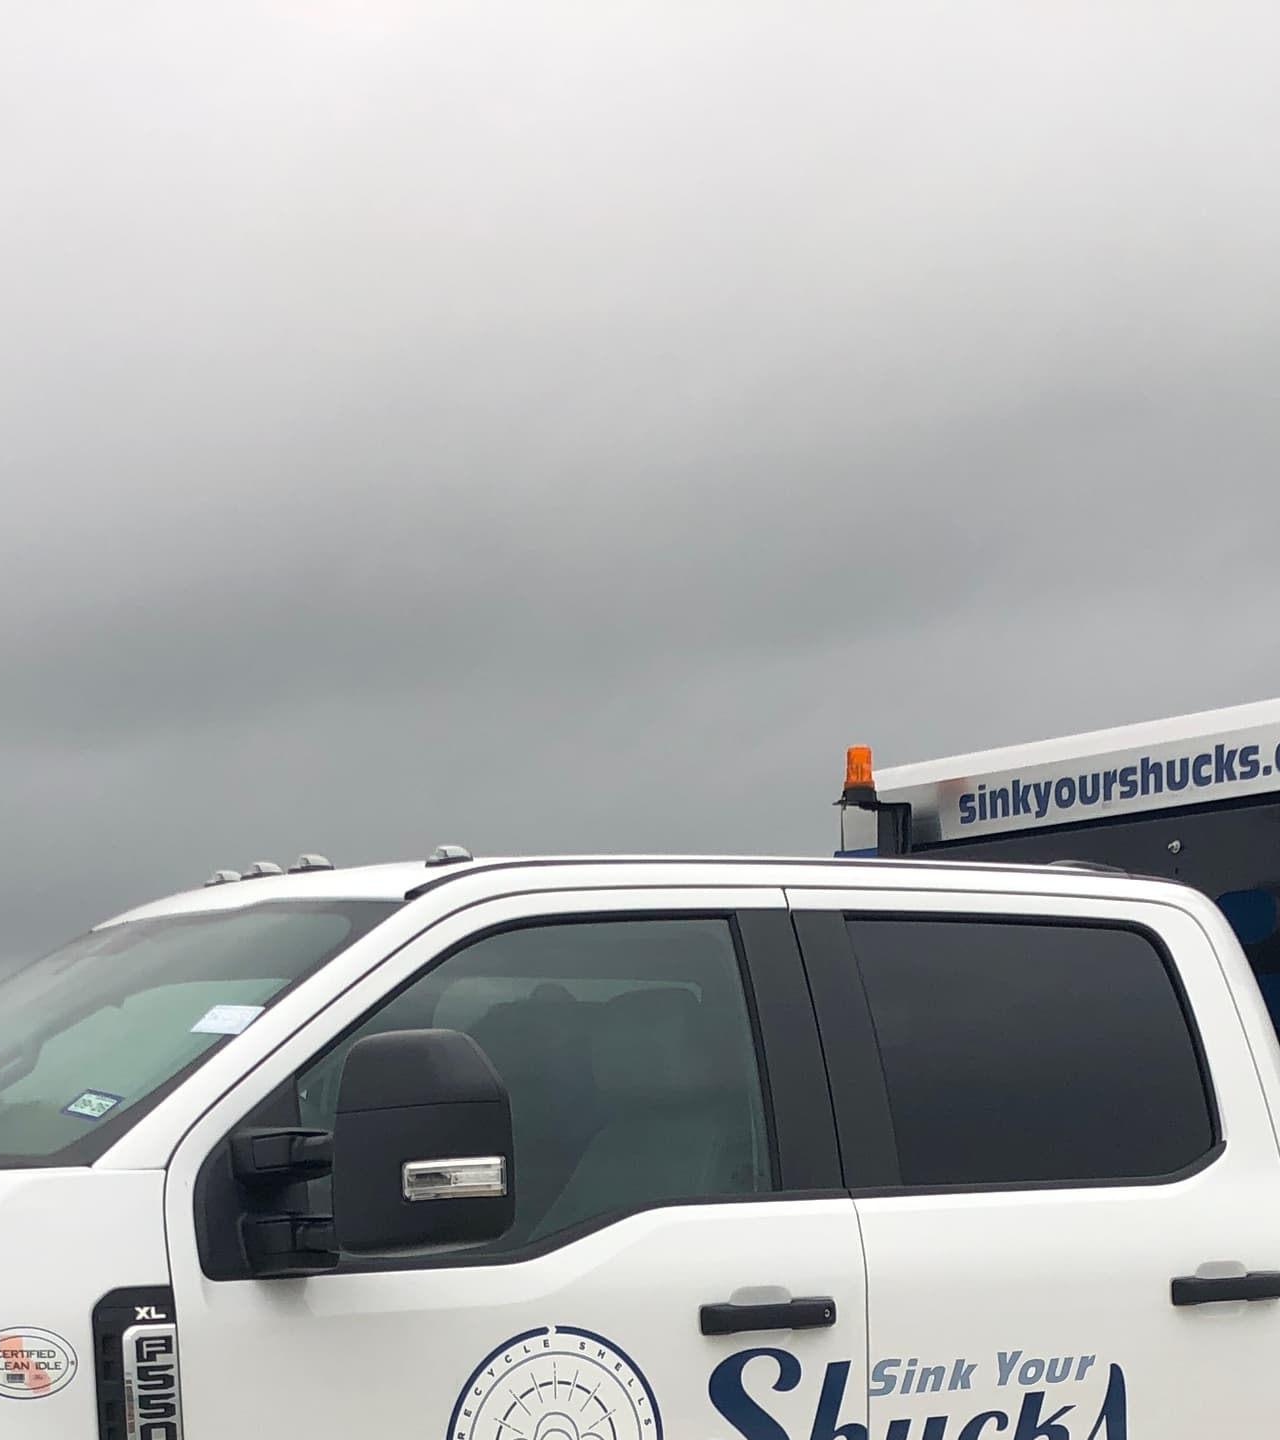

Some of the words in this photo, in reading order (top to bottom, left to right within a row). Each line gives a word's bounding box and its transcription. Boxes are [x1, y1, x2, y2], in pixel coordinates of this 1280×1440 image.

[135, 1306, 166, 1320] XL
[35, 1361, 62, 1370] IDLE
[869, 1357, 978, 1397] Sink
[997, 1351, 1096, 1387] Your
[457, 1339, 551, 1440] RECYCLE
[578, 1341, 653, 1426] SHELLS
